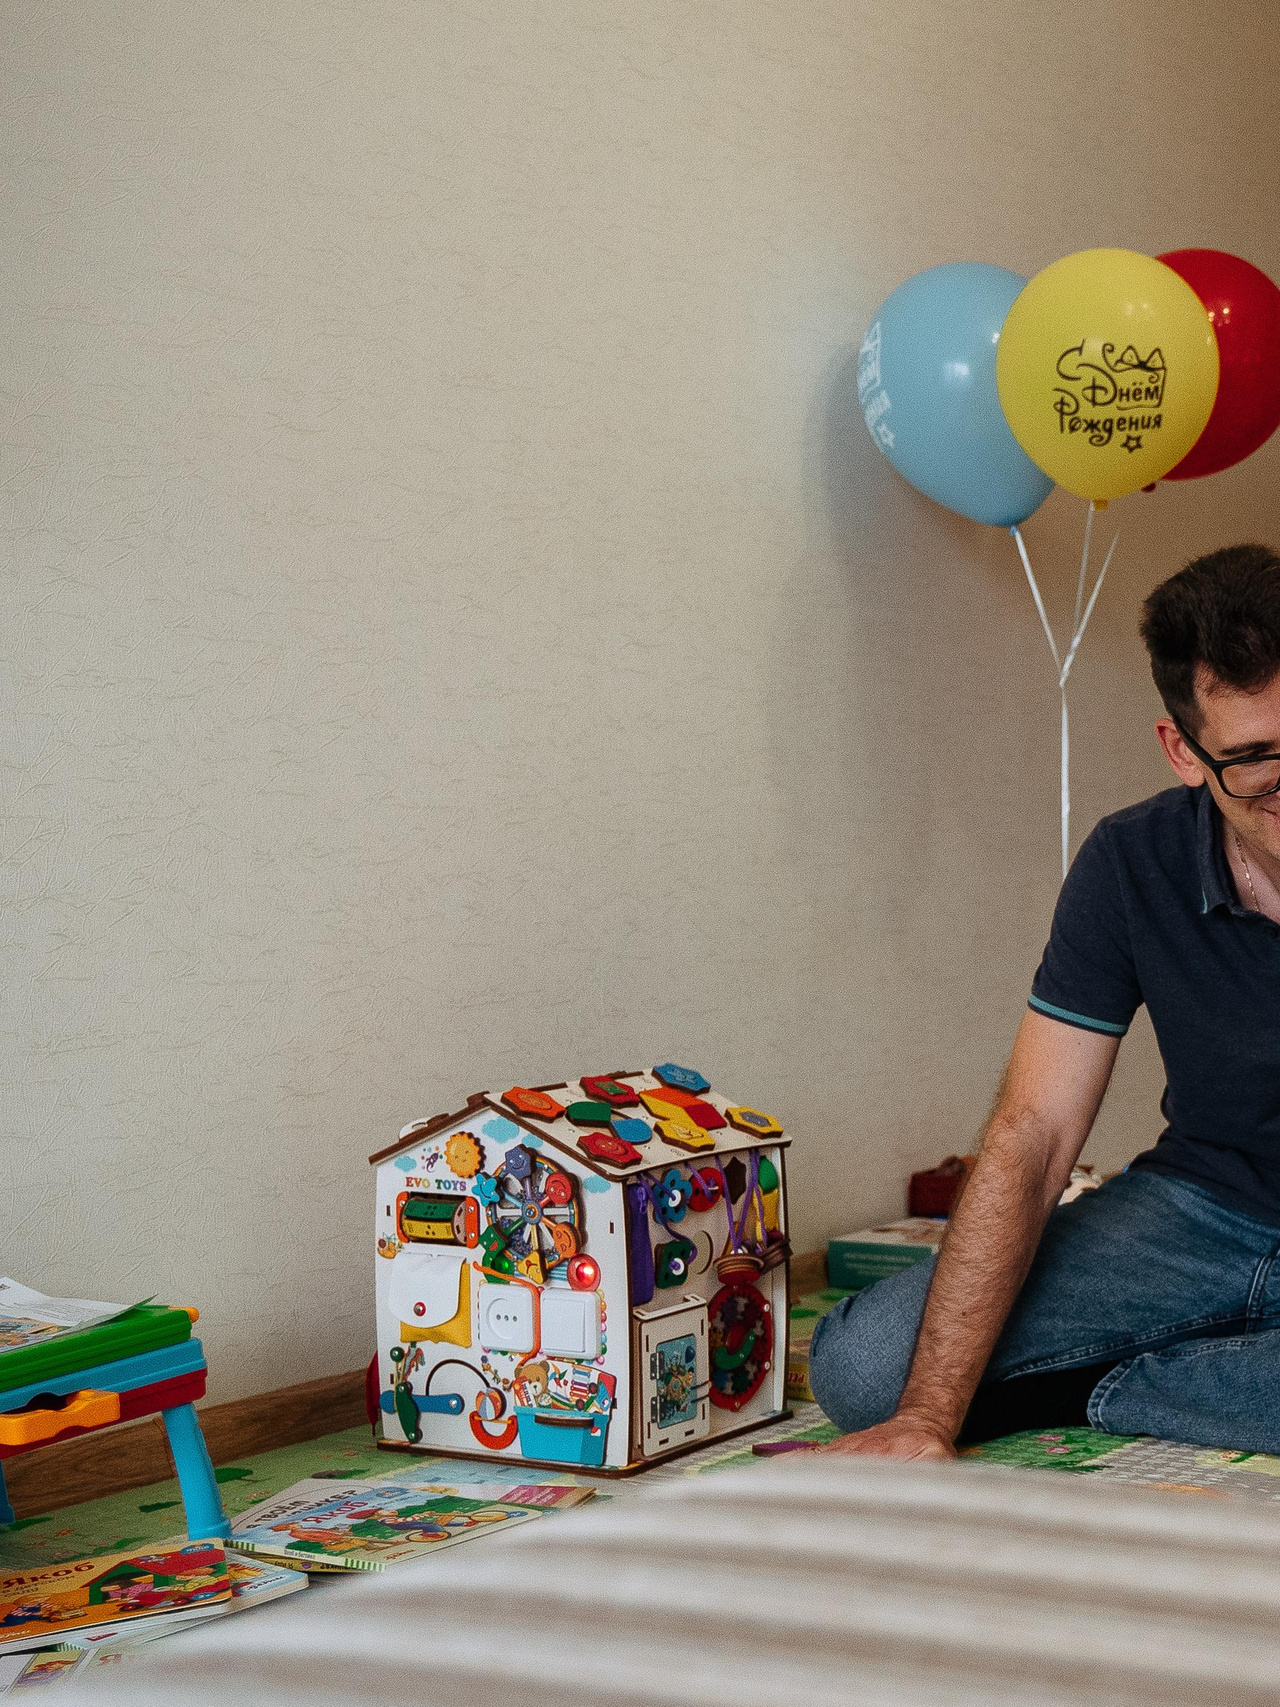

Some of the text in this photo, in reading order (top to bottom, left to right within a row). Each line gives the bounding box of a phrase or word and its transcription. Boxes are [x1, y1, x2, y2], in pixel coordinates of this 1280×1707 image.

[1056, 339, 1086, 381] С
[1052, 388, 1163, 447] Рождения
[406, 1177, 467, 1191] EVO TOYS
[3, 1561, 95, 1588] Якоб
